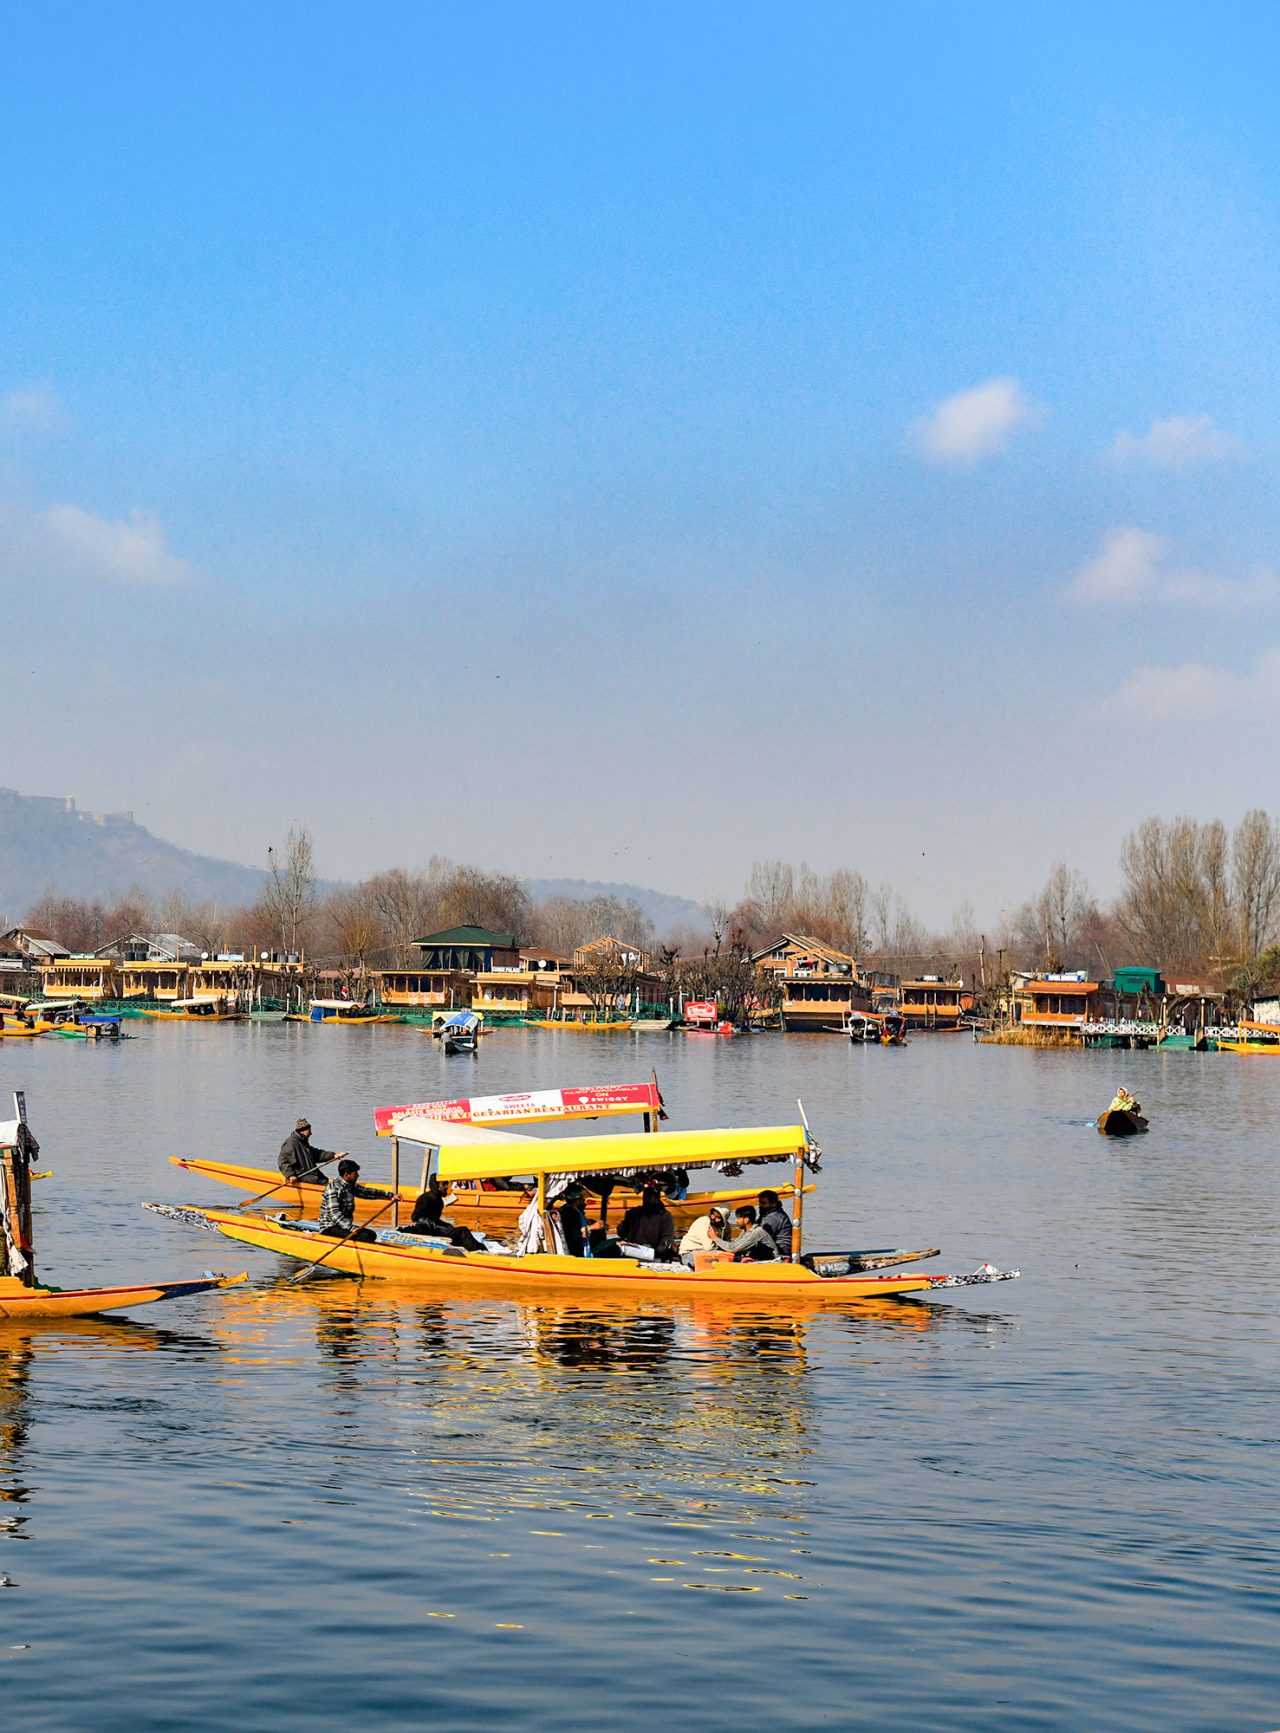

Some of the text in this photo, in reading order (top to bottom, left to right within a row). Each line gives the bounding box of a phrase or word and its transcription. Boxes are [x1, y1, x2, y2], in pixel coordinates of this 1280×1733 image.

[458, 1108, 532, 1119] VEGETARIAN
[534, 1104, 610, 1114] RESTAURANT
[504, 1102, 536, 1110] SWEETS
